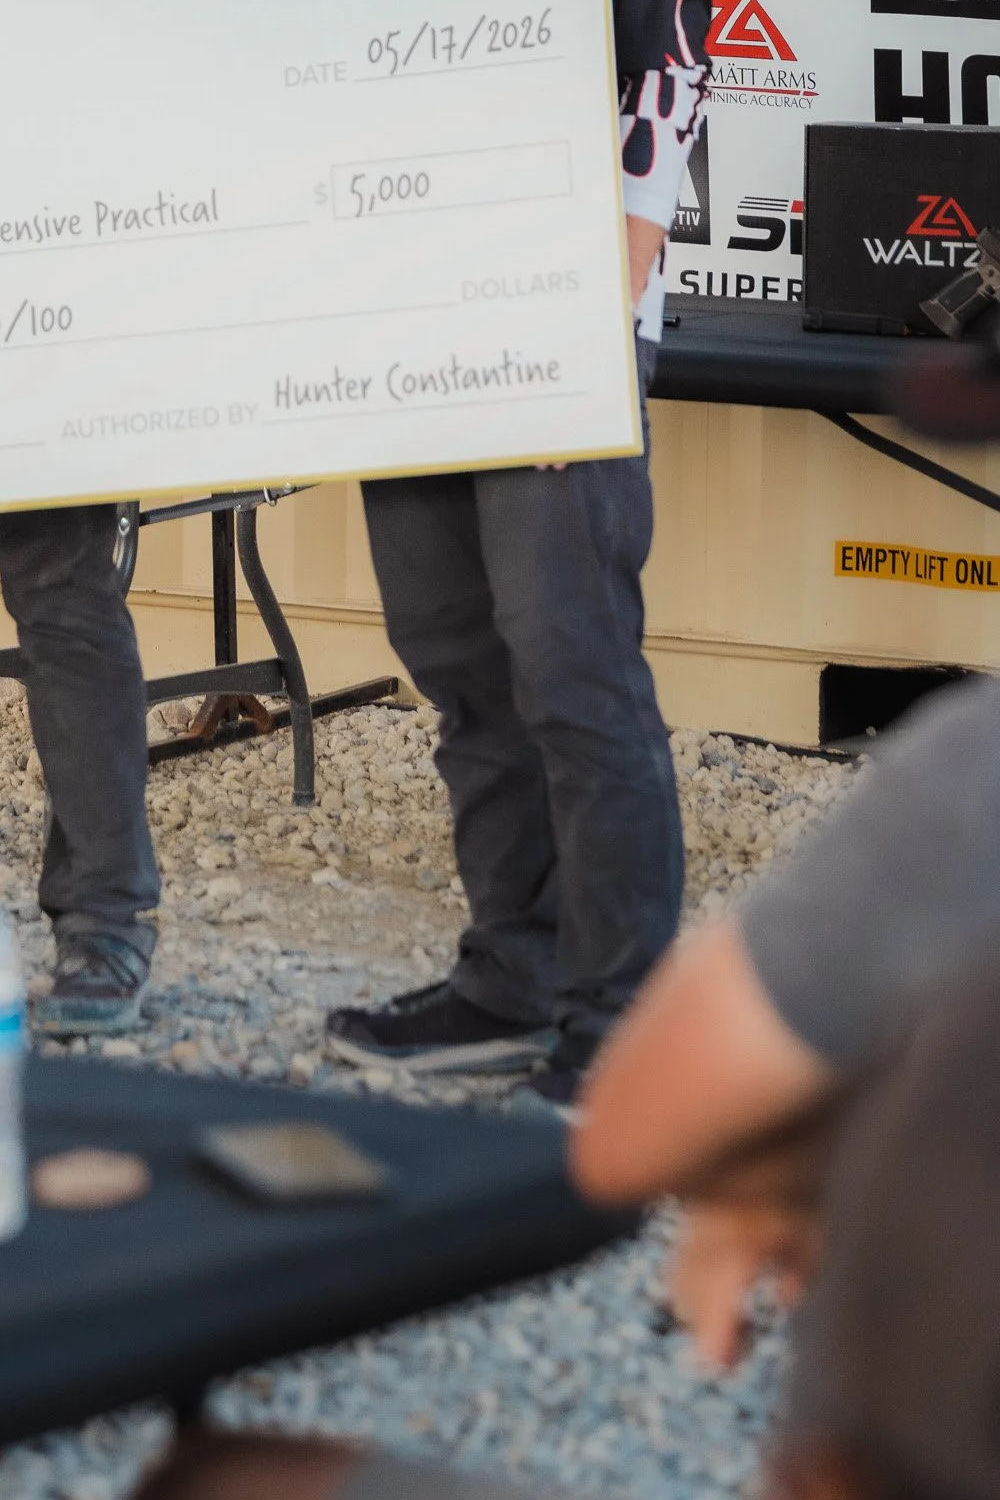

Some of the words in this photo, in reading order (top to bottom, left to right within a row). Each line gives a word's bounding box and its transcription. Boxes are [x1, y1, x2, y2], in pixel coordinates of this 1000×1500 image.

[284, 61, 348, 88] DATE
[366, 7, 553, 75] 05/17/2026
[708, 62, 759, 86] MÄTT
[763, 69, 816, 90] ARMS
[750, 93, 815, 110] ACCURACY
[94, 188, 220, 238] Practical
[350, 170, 431, 218] 5,000
[460, 269, 580, 302] DOLLARS
[274, 366, 373, 411] Hunter
[385, 349, 562, 403] Constantine
[61, 405, 220, 441] AUTHORIZED
[227, 402, 259, 428] BY
[841, 545, 911, 576] EMPTY
[915, 552, 949, 583] LIFT
[955, 558, 999, 586] ONL
